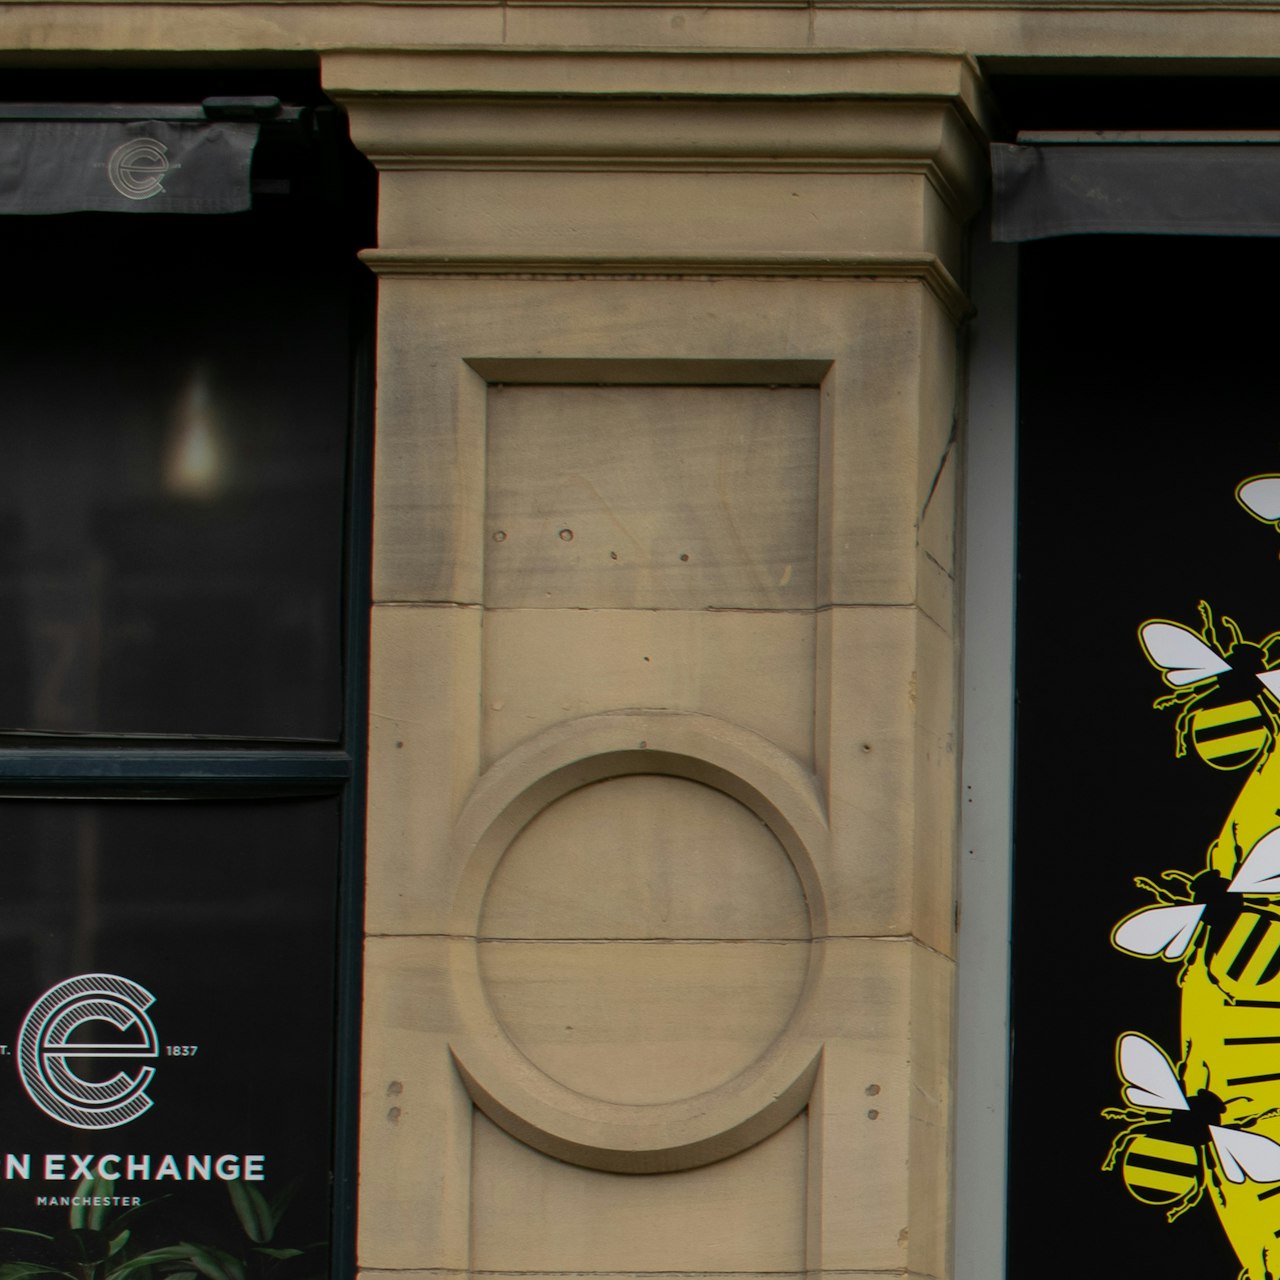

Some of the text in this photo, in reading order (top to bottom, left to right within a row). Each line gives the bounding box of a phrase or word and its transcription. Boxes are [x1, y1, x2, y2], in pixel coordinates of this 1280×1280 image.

[165, 1046, 198, 1056] 1837
[44, 1154, 265, 1180] EXCHANGE
[36, 1196, 141, 1206] MANCHESTER
